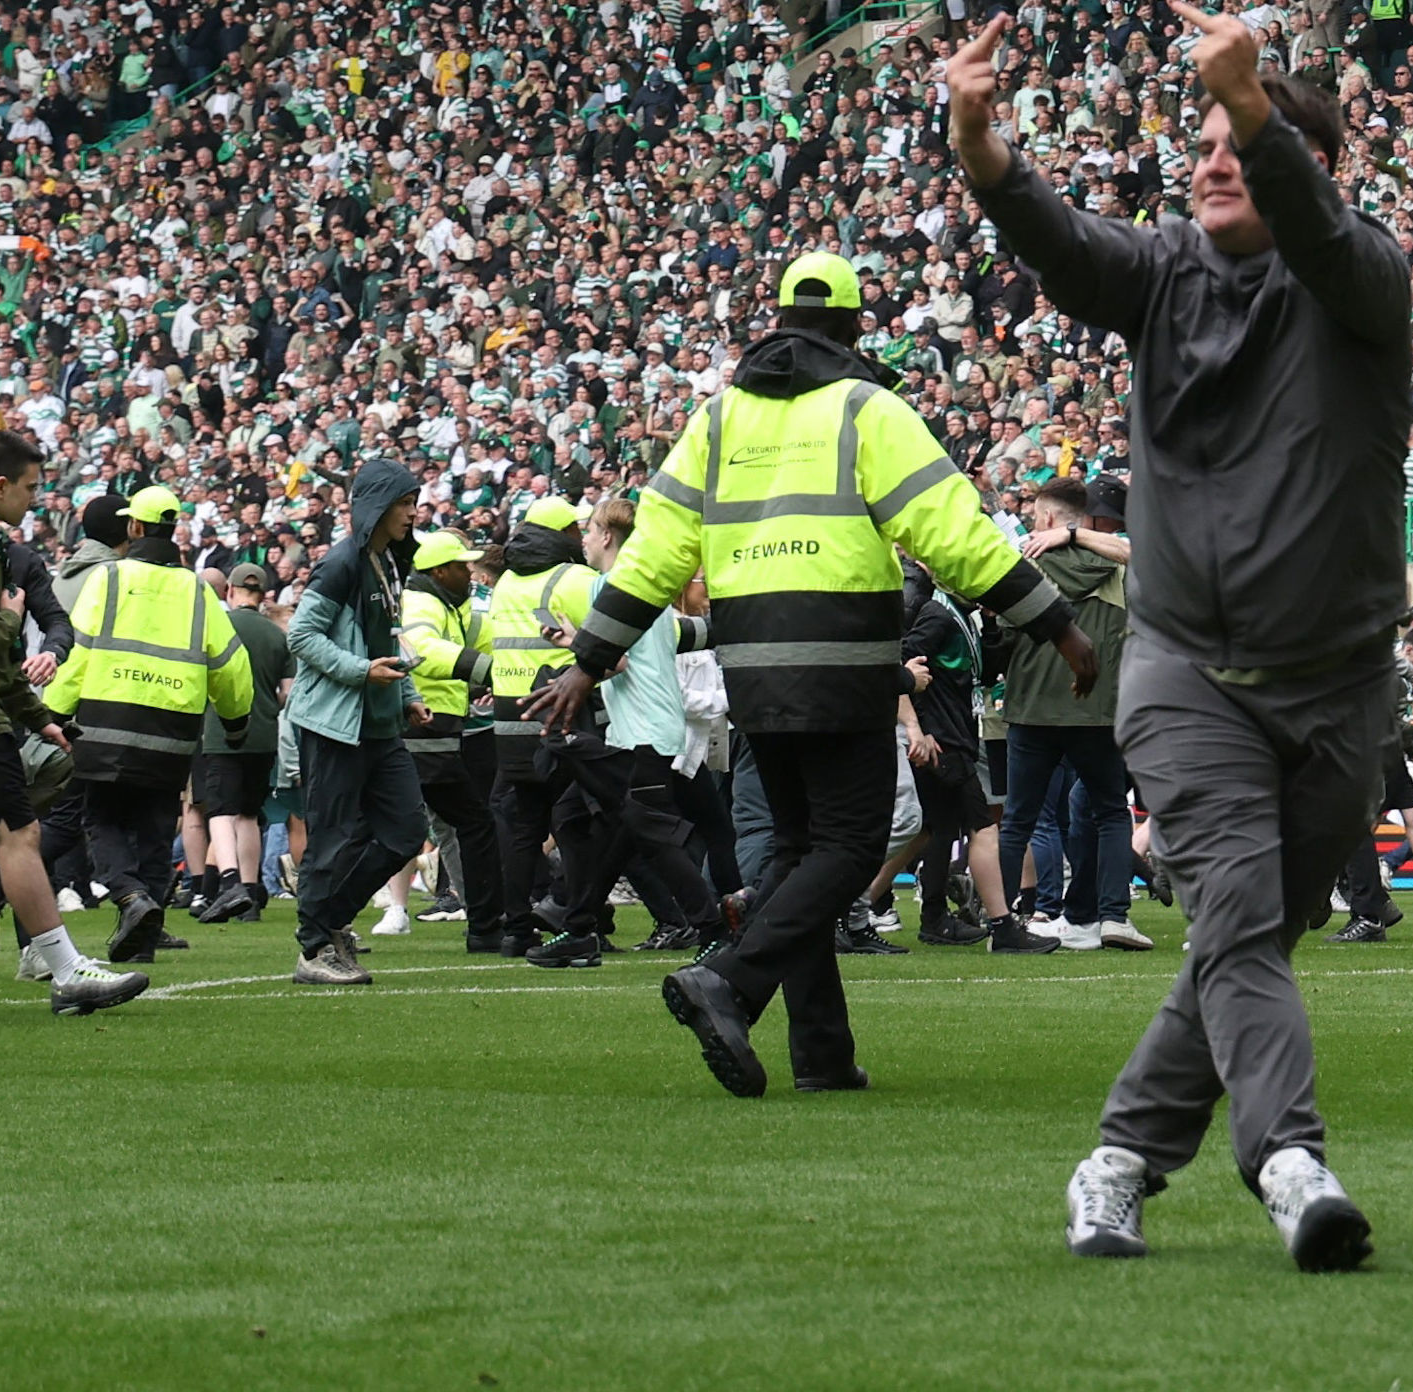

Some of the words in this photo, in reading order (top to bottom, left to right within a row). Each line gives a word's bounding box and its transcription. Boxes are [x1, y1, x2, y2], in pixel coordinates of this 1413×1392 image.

[746, 445, 781, 455] SECURITY
[732, 539, 821, 565] STEWARD
[112, 666, 184, 691] STEWARD
